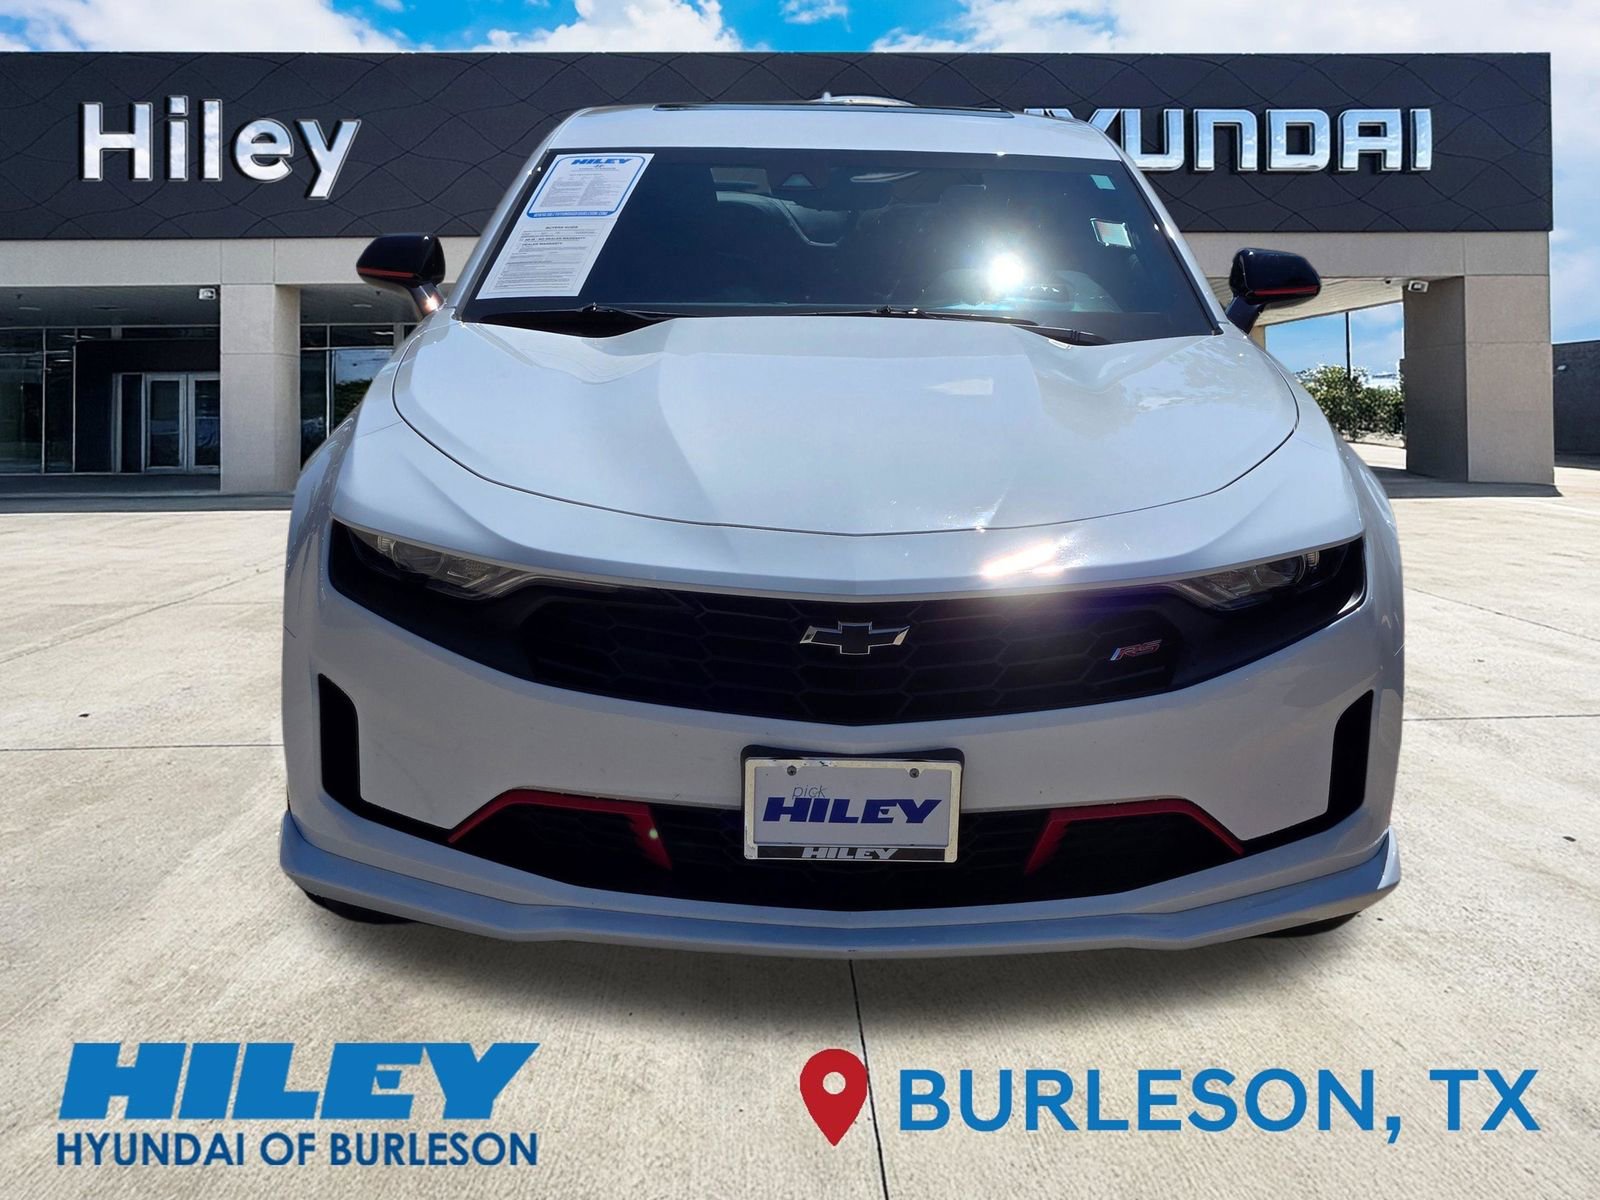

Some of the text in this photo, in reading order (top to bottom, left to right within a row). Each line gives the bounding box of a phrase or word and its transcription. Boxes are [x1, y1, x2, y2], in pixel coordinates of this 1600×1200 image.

[80, 95, 361, 200] Hiley
[1023, 107, 1432, 172] UNDAI
[792, 784, 828, 799] pick
[763, 797, 942, 823] HILEY
[801, 847, 899, 859] HILEY
